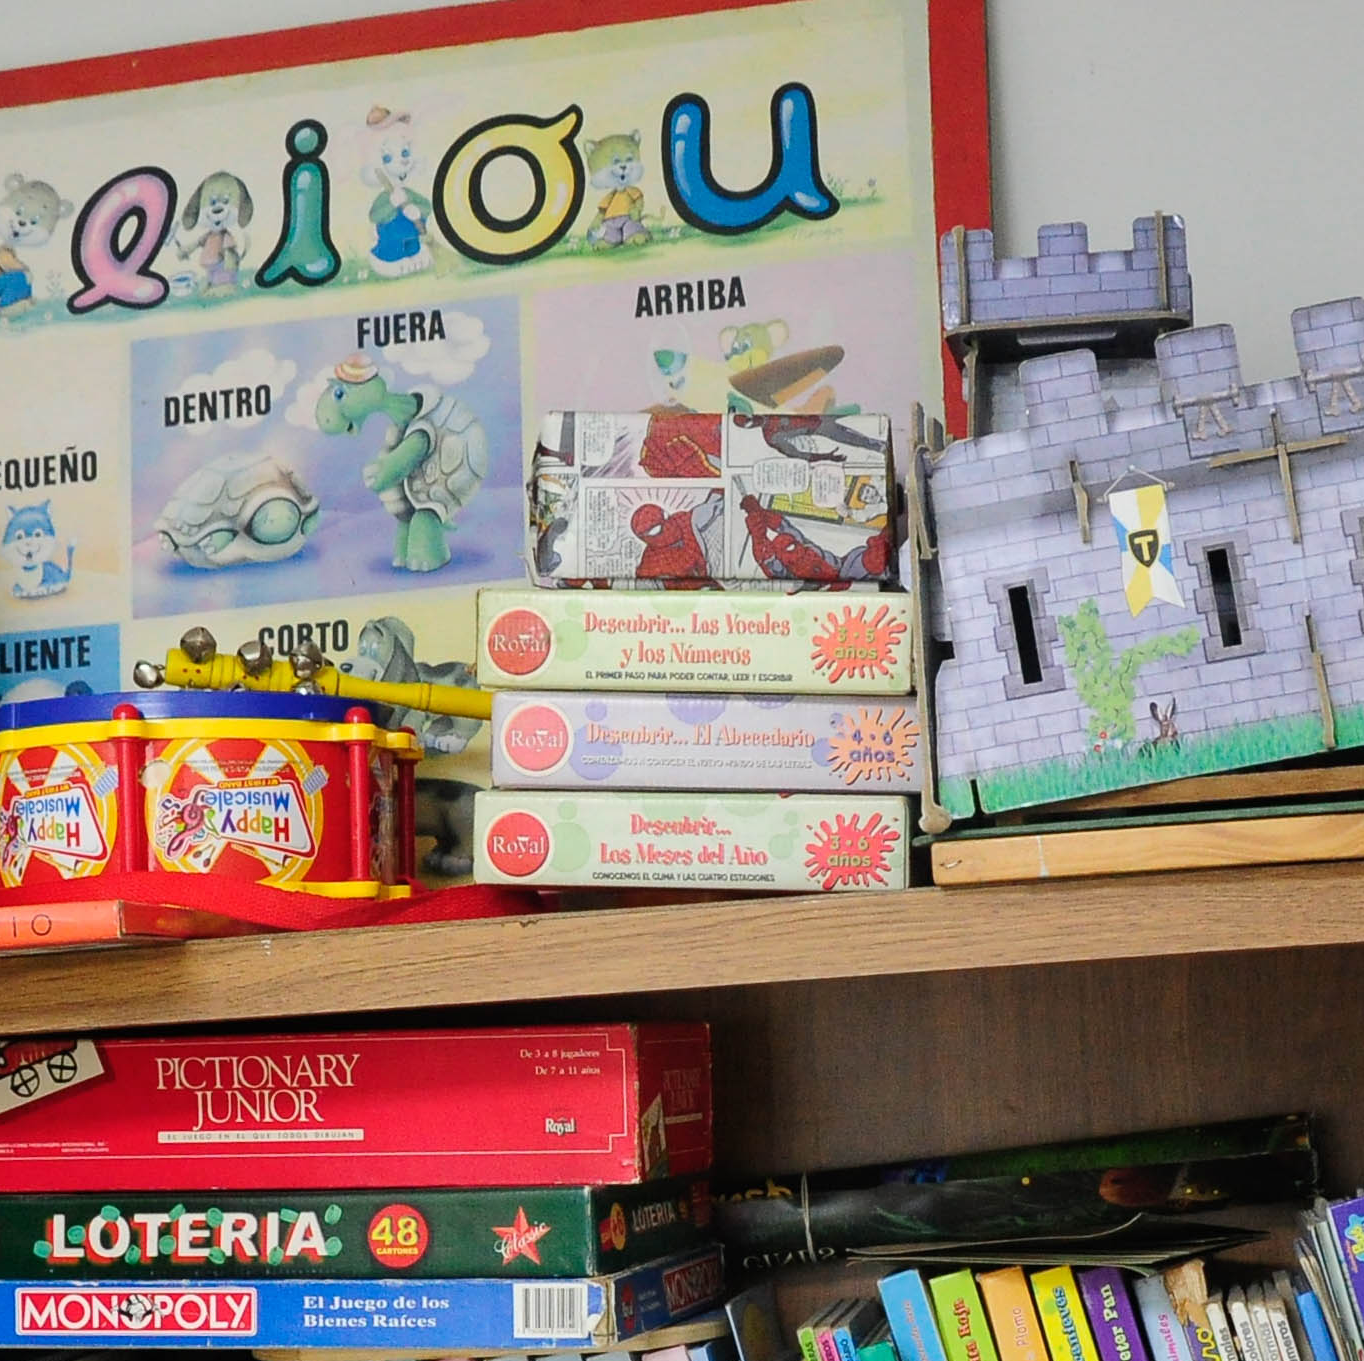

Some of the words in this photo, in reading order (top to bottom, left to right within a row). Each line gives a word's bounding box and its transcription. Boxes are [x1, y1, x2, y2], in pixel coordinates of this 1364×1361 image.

[67, 166, 177, 314] e
[254, 119, 341, 287] i
[434, 104, 585, 265] o
[661, 82, 840, 235] u
[635, 275, 746, 318] ARRIBA
[357, 309, 446, 348] FUERA
[164, 384, 272, 428] DENTRO
[1134, 536, 1157, 562] T
[584, 612, 684, 635] Descubrir...
[691, 613, 719, 635] Las
[724, 613, 790, 636] Vocales
[493, 632, 548, 662] Royal
[637, 641, 665, 664] los
[670, 640, 752, 665] Números
[833, 646, 878, 660] años
[595, 672, 622, 680] PRIMER
[624, 672, 645, 680] PASO
[648, 672, 667, 680] PARA
[510, 728, 564, 753] Royal
[586, 723, 687, 746] Descubrir...
[693, 723, 711, 745] El
[716, 723, 815, 747] Abecedario
[852, 730, 863, 746] 4
[882, 730, 894, 746] 6
[849, 746, 895, 763] años
[17, 797, 81, 820] Musicale
[203, 791, 290, 812] Musicale
[28, 817, 81, 848] Happy
[221, 809, 290, 842] Happy
[631, 814, 731, 836] Descubrir...
[492, 836, 545, 859] Royal
[600, 845, 631, 865] Los
[636, 845, 693, 865] Meses
[698, 845, 725, 864] del
[733, 844, 768, 866] Año
[858, 837, 868, 850] 6
[828, 853, 871, 868] años
[520, 1050, 532, 1058] De
[157, 1054, 360, 1091] PICTIONARY
[535, 1066, 547, 1075] De
[193, 1089, 324, 1130] JUNIOR
[545, 1118, 576, 1135] Royal
[52, 1210, 331, 1258] LOTERIA
[370, 1217, 418, 1247] 48
[494, 1220, 547, 1258] Classic
[23, 1293, 250, 1330] MONOPOLY
[303, 1297, 324, 1309] El
[334, 1296, 388, 1313] Juego
[393, 1297, 417, 1309] de
[421, 1296, 449, 1309] los
[1097, 1282, 1120, 1321] Pan
[303, 1314, 367, 1328] Bienes
[373, 1313, 437, 1328] Raíces
[948, 1295, 976, 1339] Roja
[1009, 1306, 1030, 1347] Plomo
